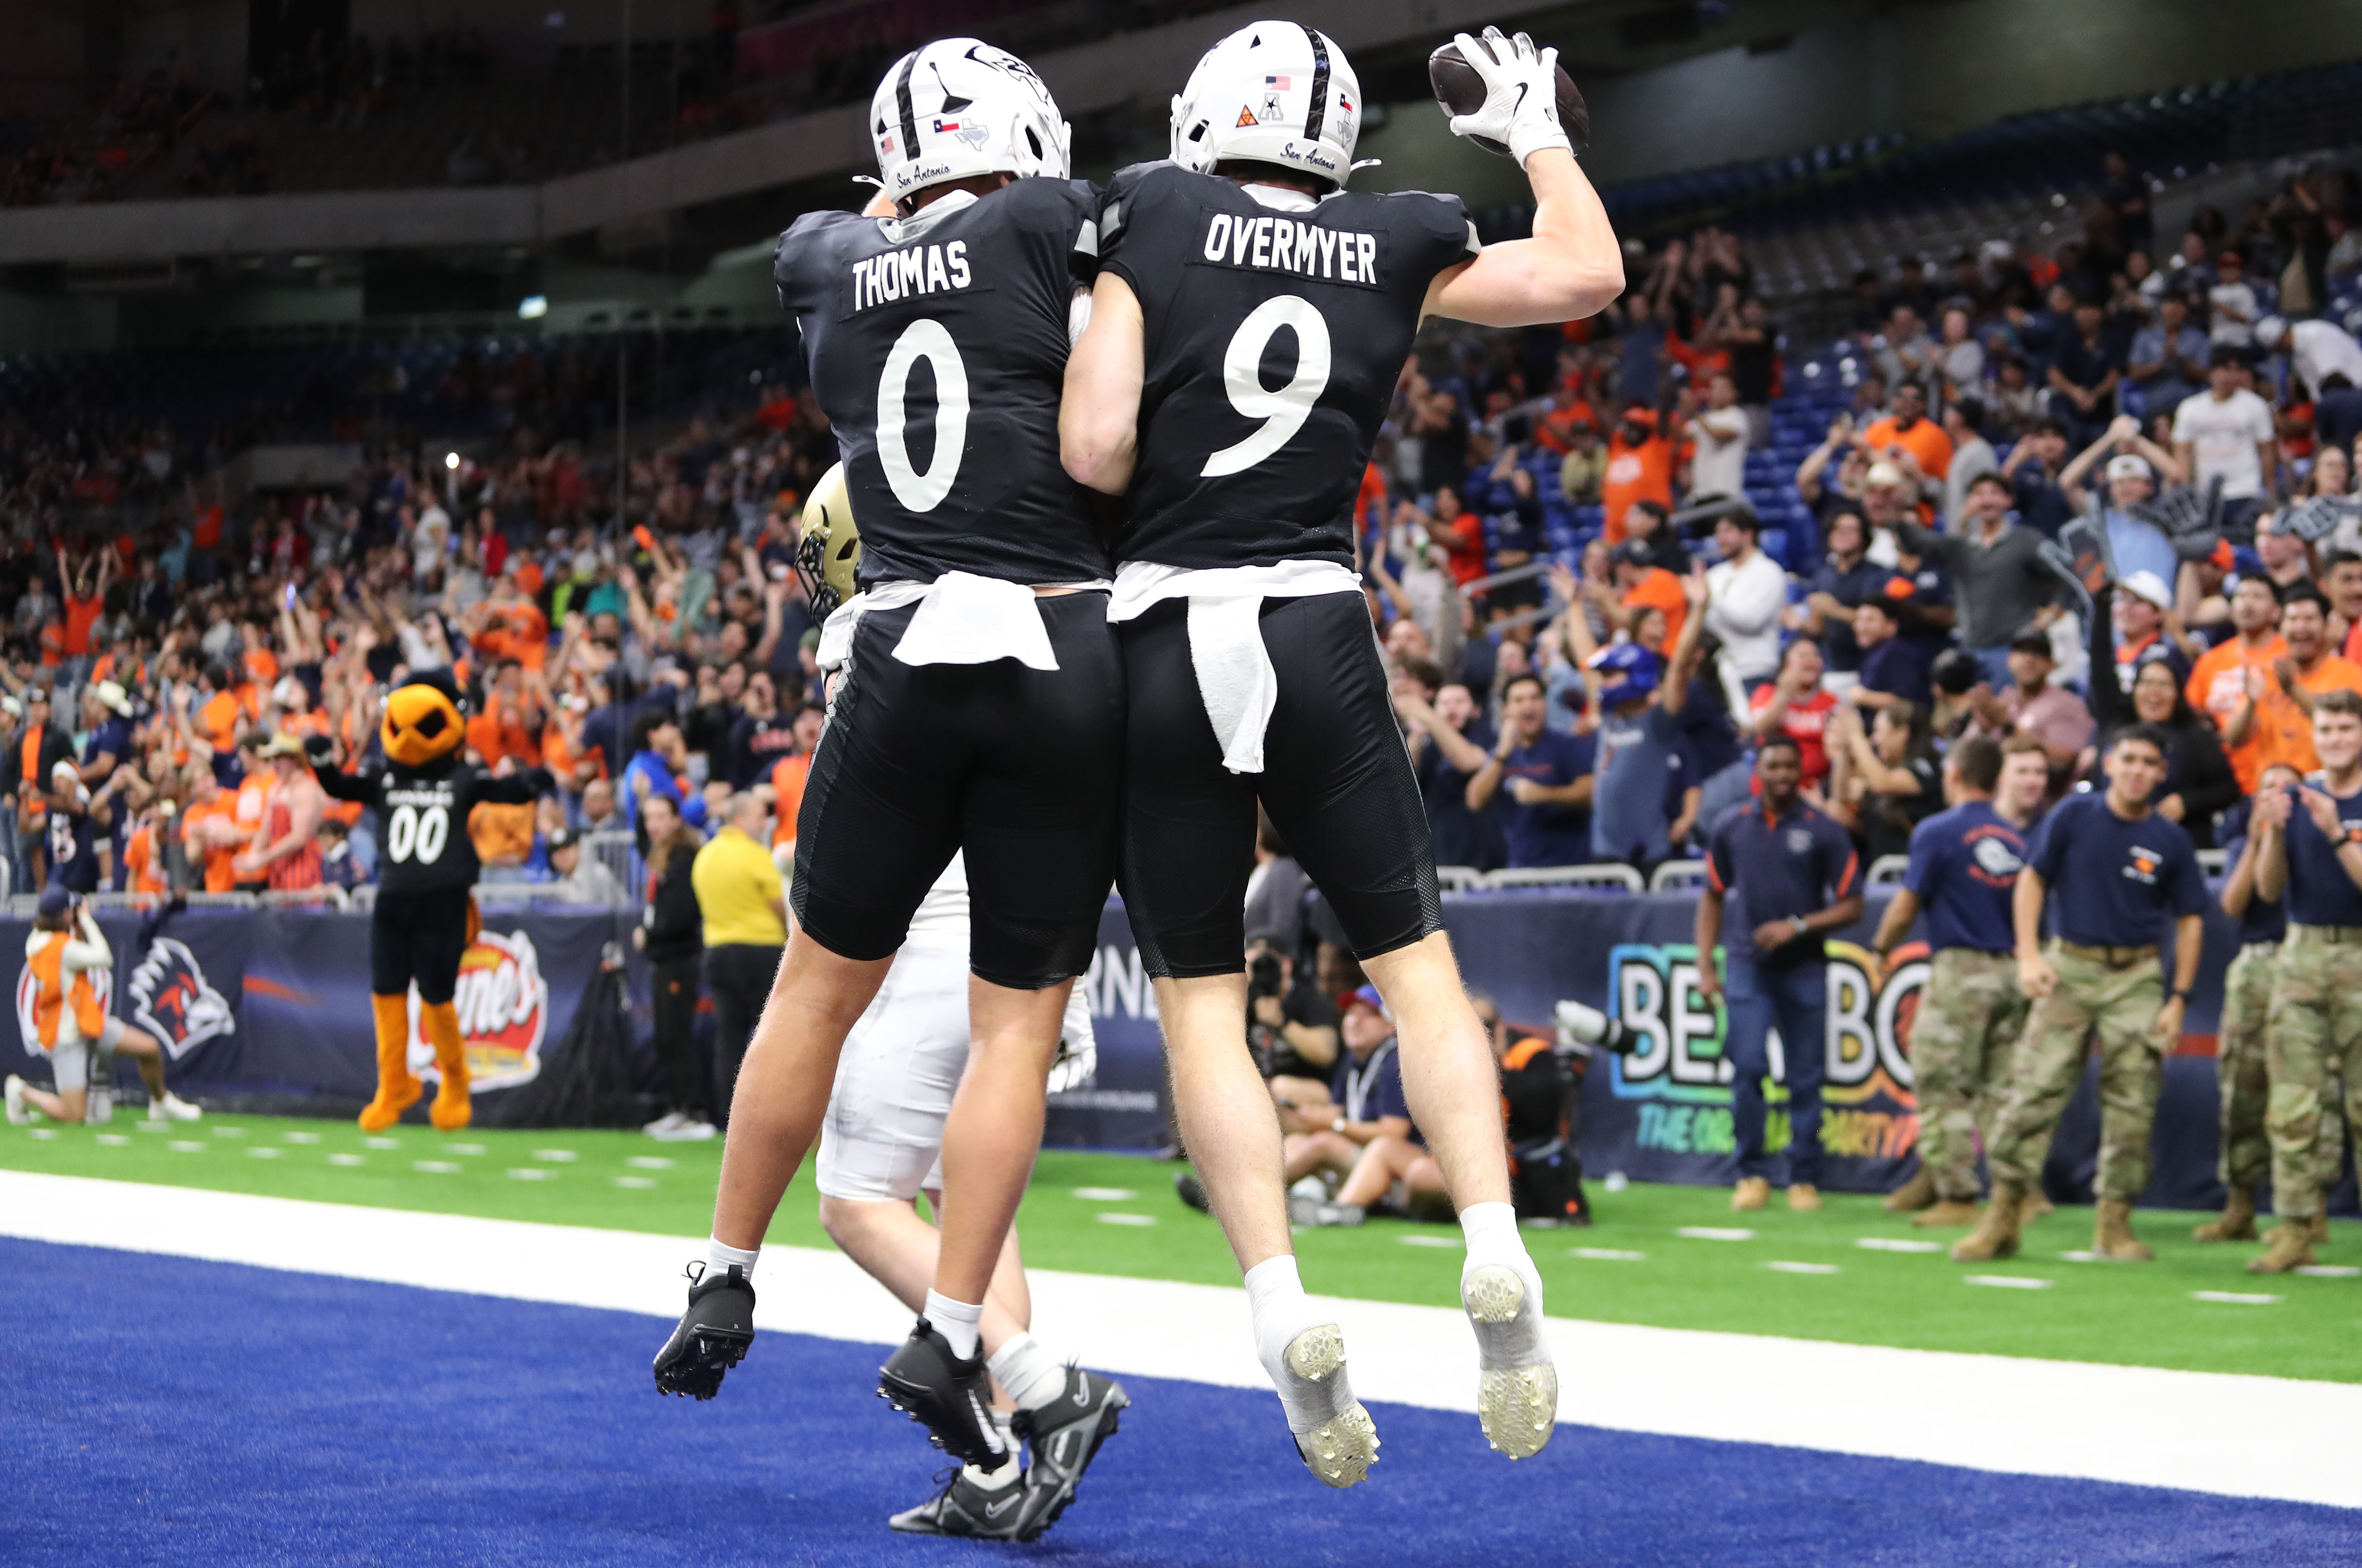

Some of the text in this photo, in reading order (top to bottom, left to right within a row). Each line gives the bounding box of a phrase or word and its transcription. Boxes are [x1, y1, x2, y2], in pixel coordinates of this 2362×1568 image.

[897, 163, 950, 188] San Antonio
[1280, 142, 1335, 170] San Antonio
[852, 239, 971, 312] THOMAS
[1203, 213, 1377, 285] OVERMYER
[875, 319, 970, 512] 0
[1200, 294, 1331, 477] 9
[388, 803, 450, 865] 00
[1637, 1103, 1696, 1154] THE
